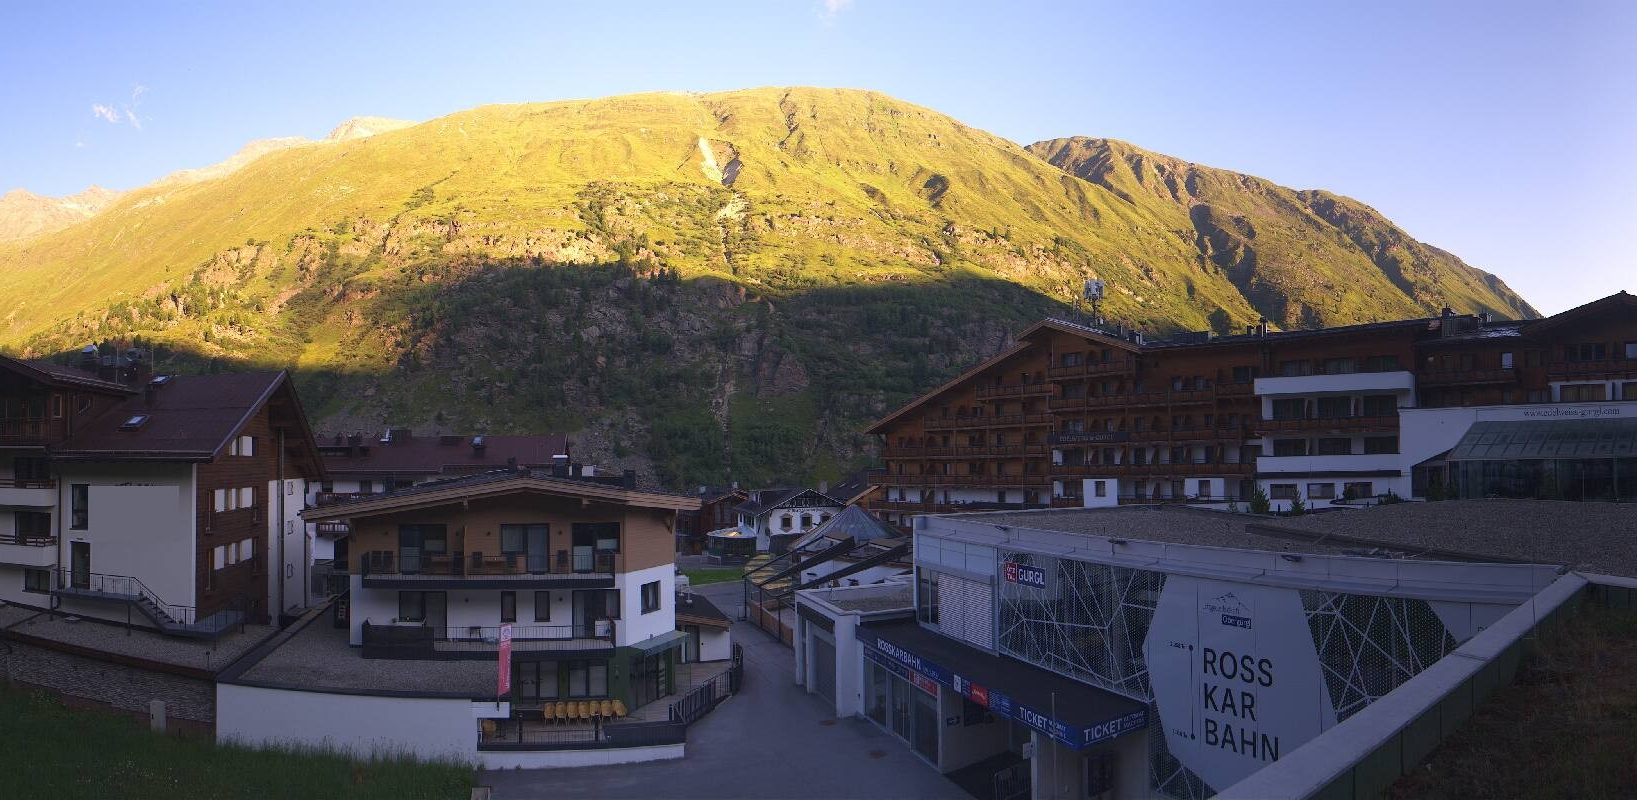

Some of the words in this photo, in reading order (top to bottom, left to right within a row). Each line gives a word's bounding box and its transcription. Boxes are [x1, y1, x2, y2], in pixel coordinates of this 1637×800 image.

[1018, 568, 1045, 586] GURGL
[877, 638, 921, 671] ROSSKARBAHN
[1203, 647, 1274, 688] ROSS
[1019, 706, 1048, 730] TICKET
[1204, 683, 1257, 722] KAR
[1083, 718, 1123, 742] TICKET
[1205, 718, 1279, 762] BAHN
